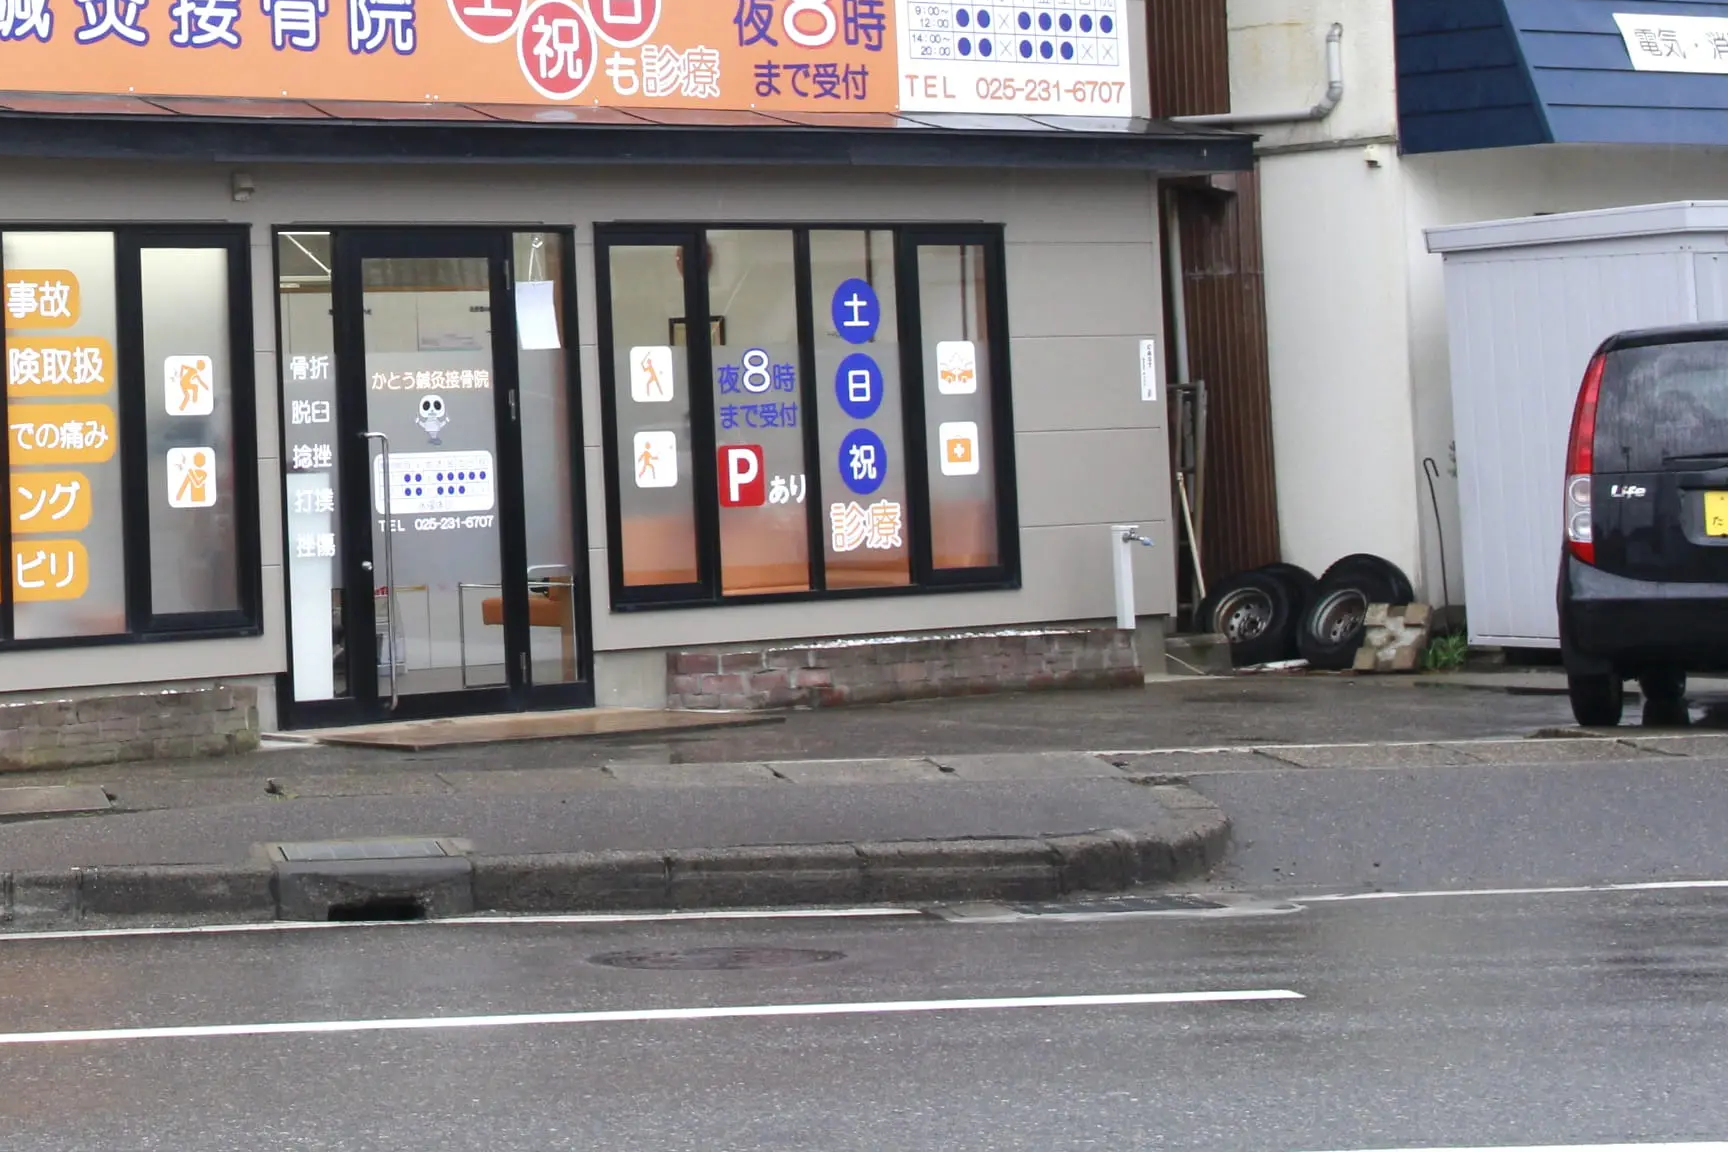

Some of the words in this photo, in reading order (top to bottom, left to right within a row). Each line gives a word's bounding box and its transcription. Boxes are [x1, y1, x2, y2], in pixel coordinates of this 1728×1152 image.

[532, 16, 581, 79] 祝
[604, 44, 721, 100] も診療
[753, 61, 870, 102] まで受付
[905, 74, 956, 99] TEL
[975, 77, 1126, 104] 025-231-6707
[843, 293, 870, 326] 土
[290, 356, 329, 380] 骨折
[371, 369, 490, 390] かとう鍼灸接骨院
[717, 348, 796, 395] 夜8時
[848, 369, 871, 402] 日
[291, 400, 330, 425] 脱臼
[719, 403, 798, 429] まで受付
[849, 444, 877, 480] 祝
[1610, 484, 1647, 499] Life
[414, 515, 494, 531] 025-231-6707
[830, 500, 902, 552] 診療
